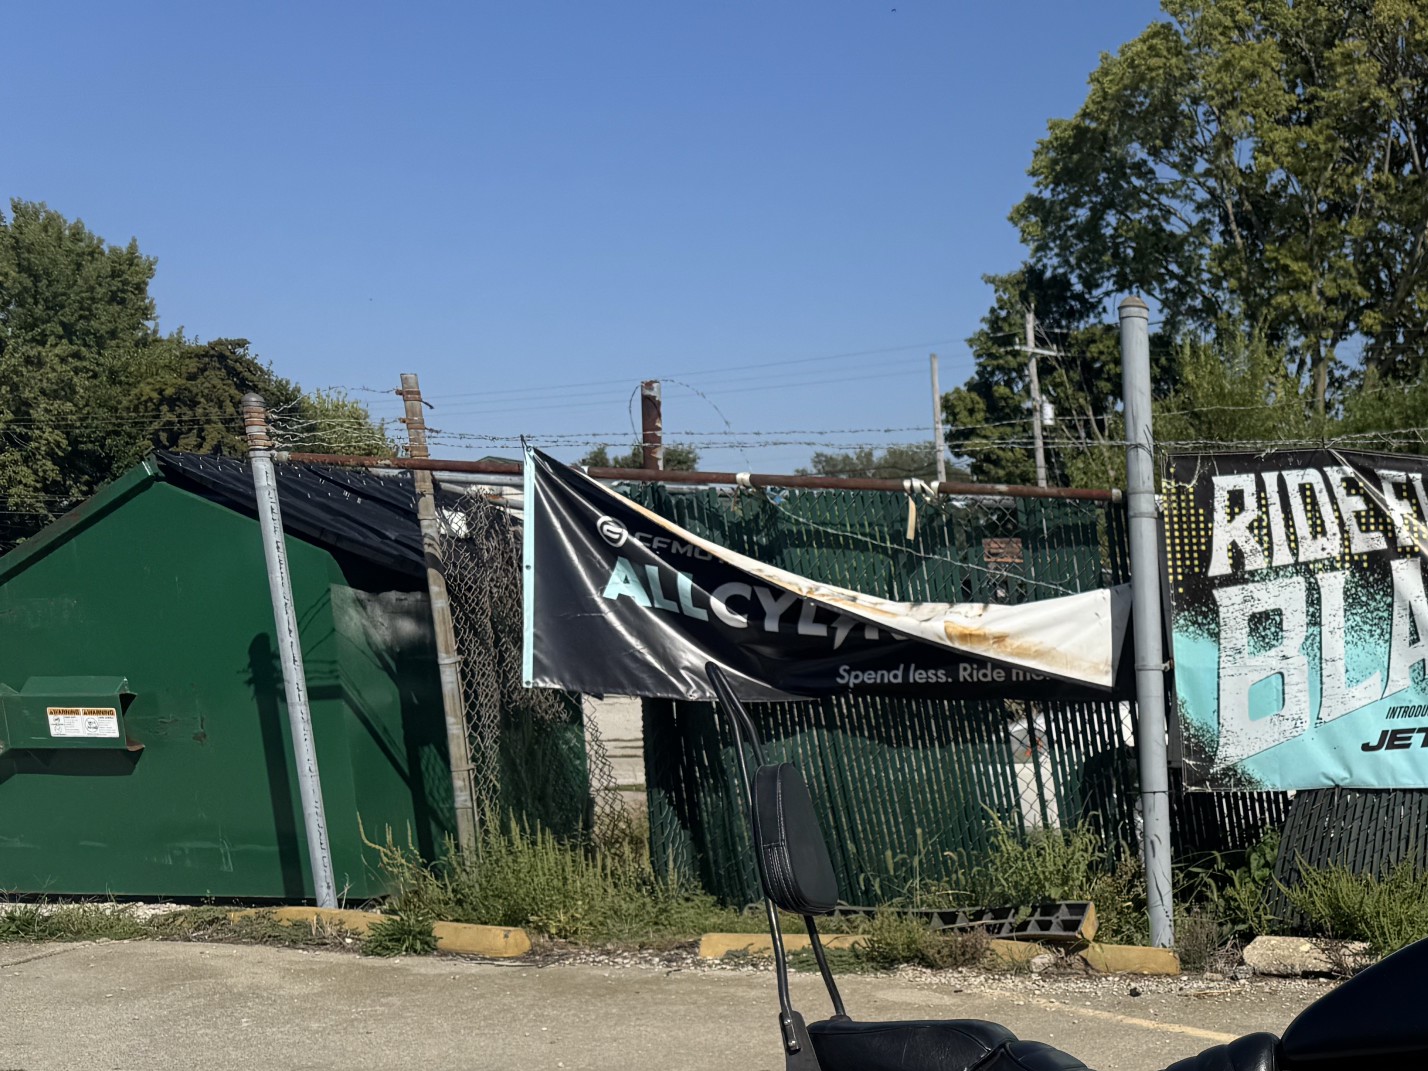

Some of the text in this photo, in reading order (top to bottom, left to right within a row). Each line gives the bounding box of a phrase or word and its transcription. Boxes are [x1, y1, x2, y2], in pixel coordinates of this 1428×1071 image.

[1207, 465, 1388, 577] RIDE
[634, 531, 724, 564] CFMO
[836, 664, 904, 688] Spend
[909, 664, 952, 683] less.
[958, 663, 1006, 682] Ride
[52, 708, 80, 716] WARNING
